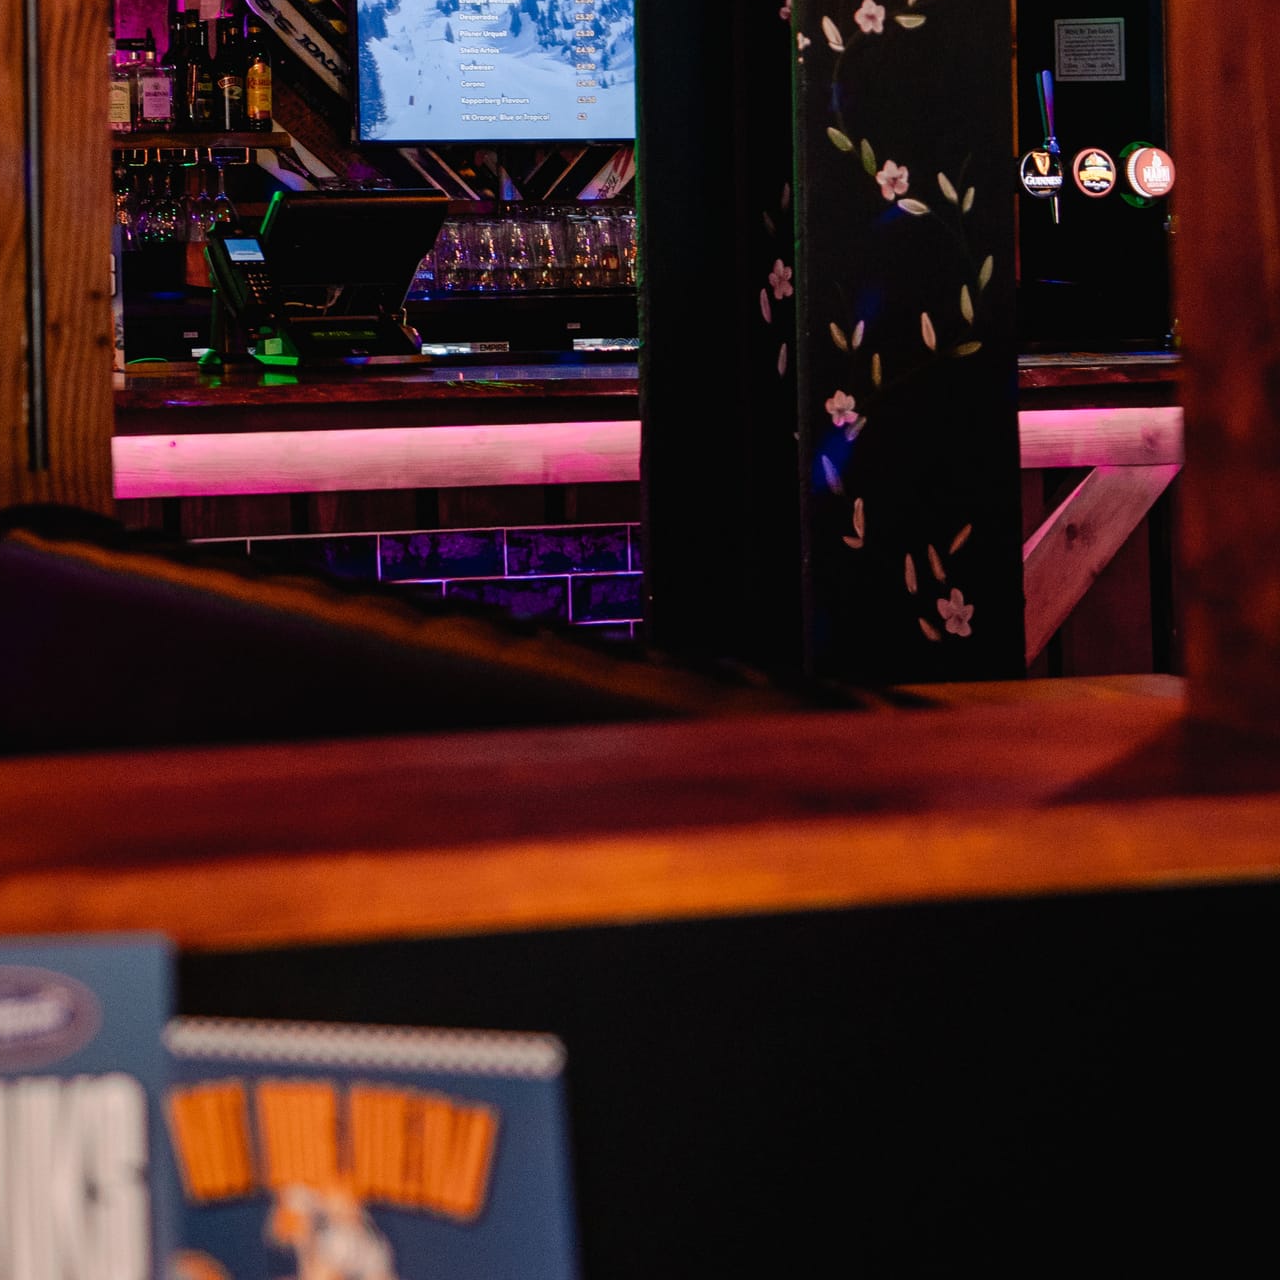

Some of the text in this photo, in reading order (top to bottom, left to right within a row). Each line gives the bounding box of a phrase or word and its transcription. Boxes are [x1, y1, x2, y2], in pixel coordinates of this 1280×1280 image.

[459, 14, 499, 22] Desperados
[483, 30, 507, 38] Urquell
[461, 80, 486, 88] Corona
[461, 97, 501, 105] Kopparberg
[1027, 176, 1063, 187] GUINNESS
[478, 342, 509, 353] EMPIRE
